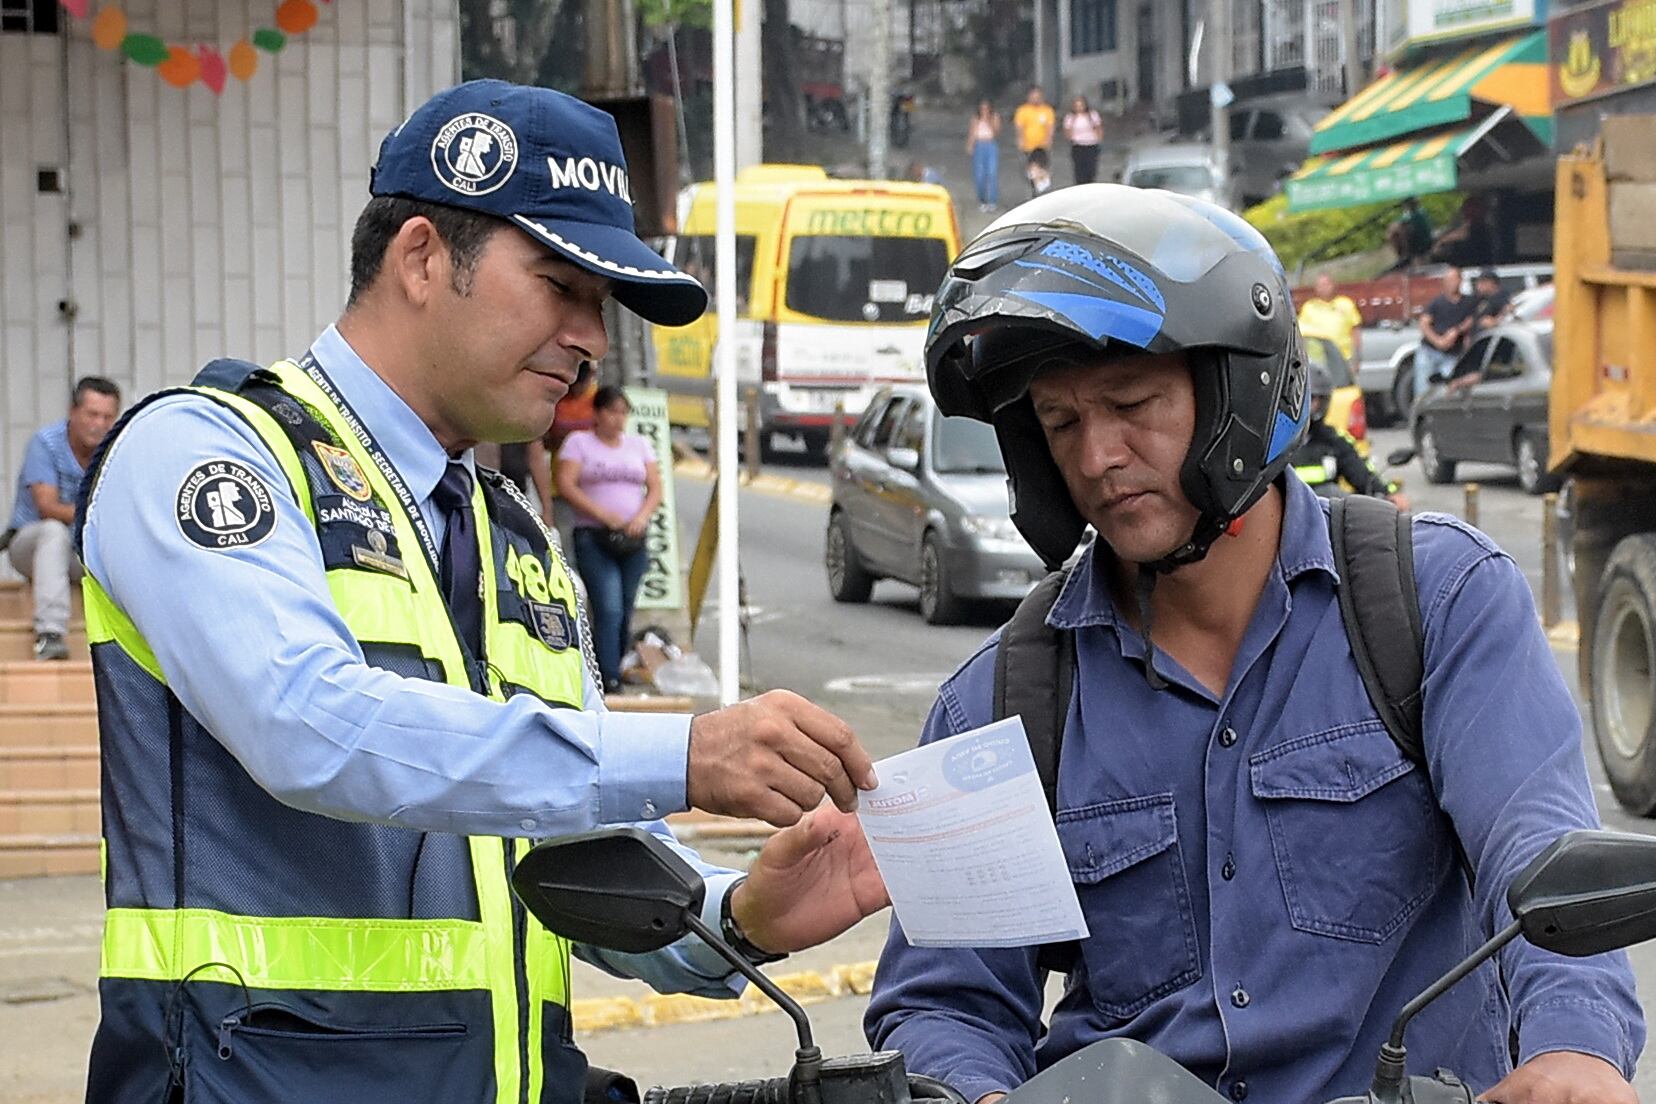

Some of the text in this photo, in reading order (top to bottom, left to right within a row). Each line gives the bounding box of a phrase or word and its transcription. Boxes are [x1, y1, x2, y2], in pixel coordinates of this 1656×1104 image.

[437, 117, 514, 163] AGENTES DE TRANSITO
[452, 176, 477, 192] CALI
[547, 156, 633, 207] MOVIL
[180, 463, 272, 520] AGENTES DE TRANSITO
[306, 365, 333, 394] AGENTE
[330, 391, 342, 405] DE
[338, 403, 372, 448] TRANSITO
[371, 451, 412, 507] SECRETARÍA
[407, 505, 420, 521] DE
[415, 519, 440, 574] MOVILIDA
[217, 532, 249, 546] CALI
[505, 543, 577, 621] 484
